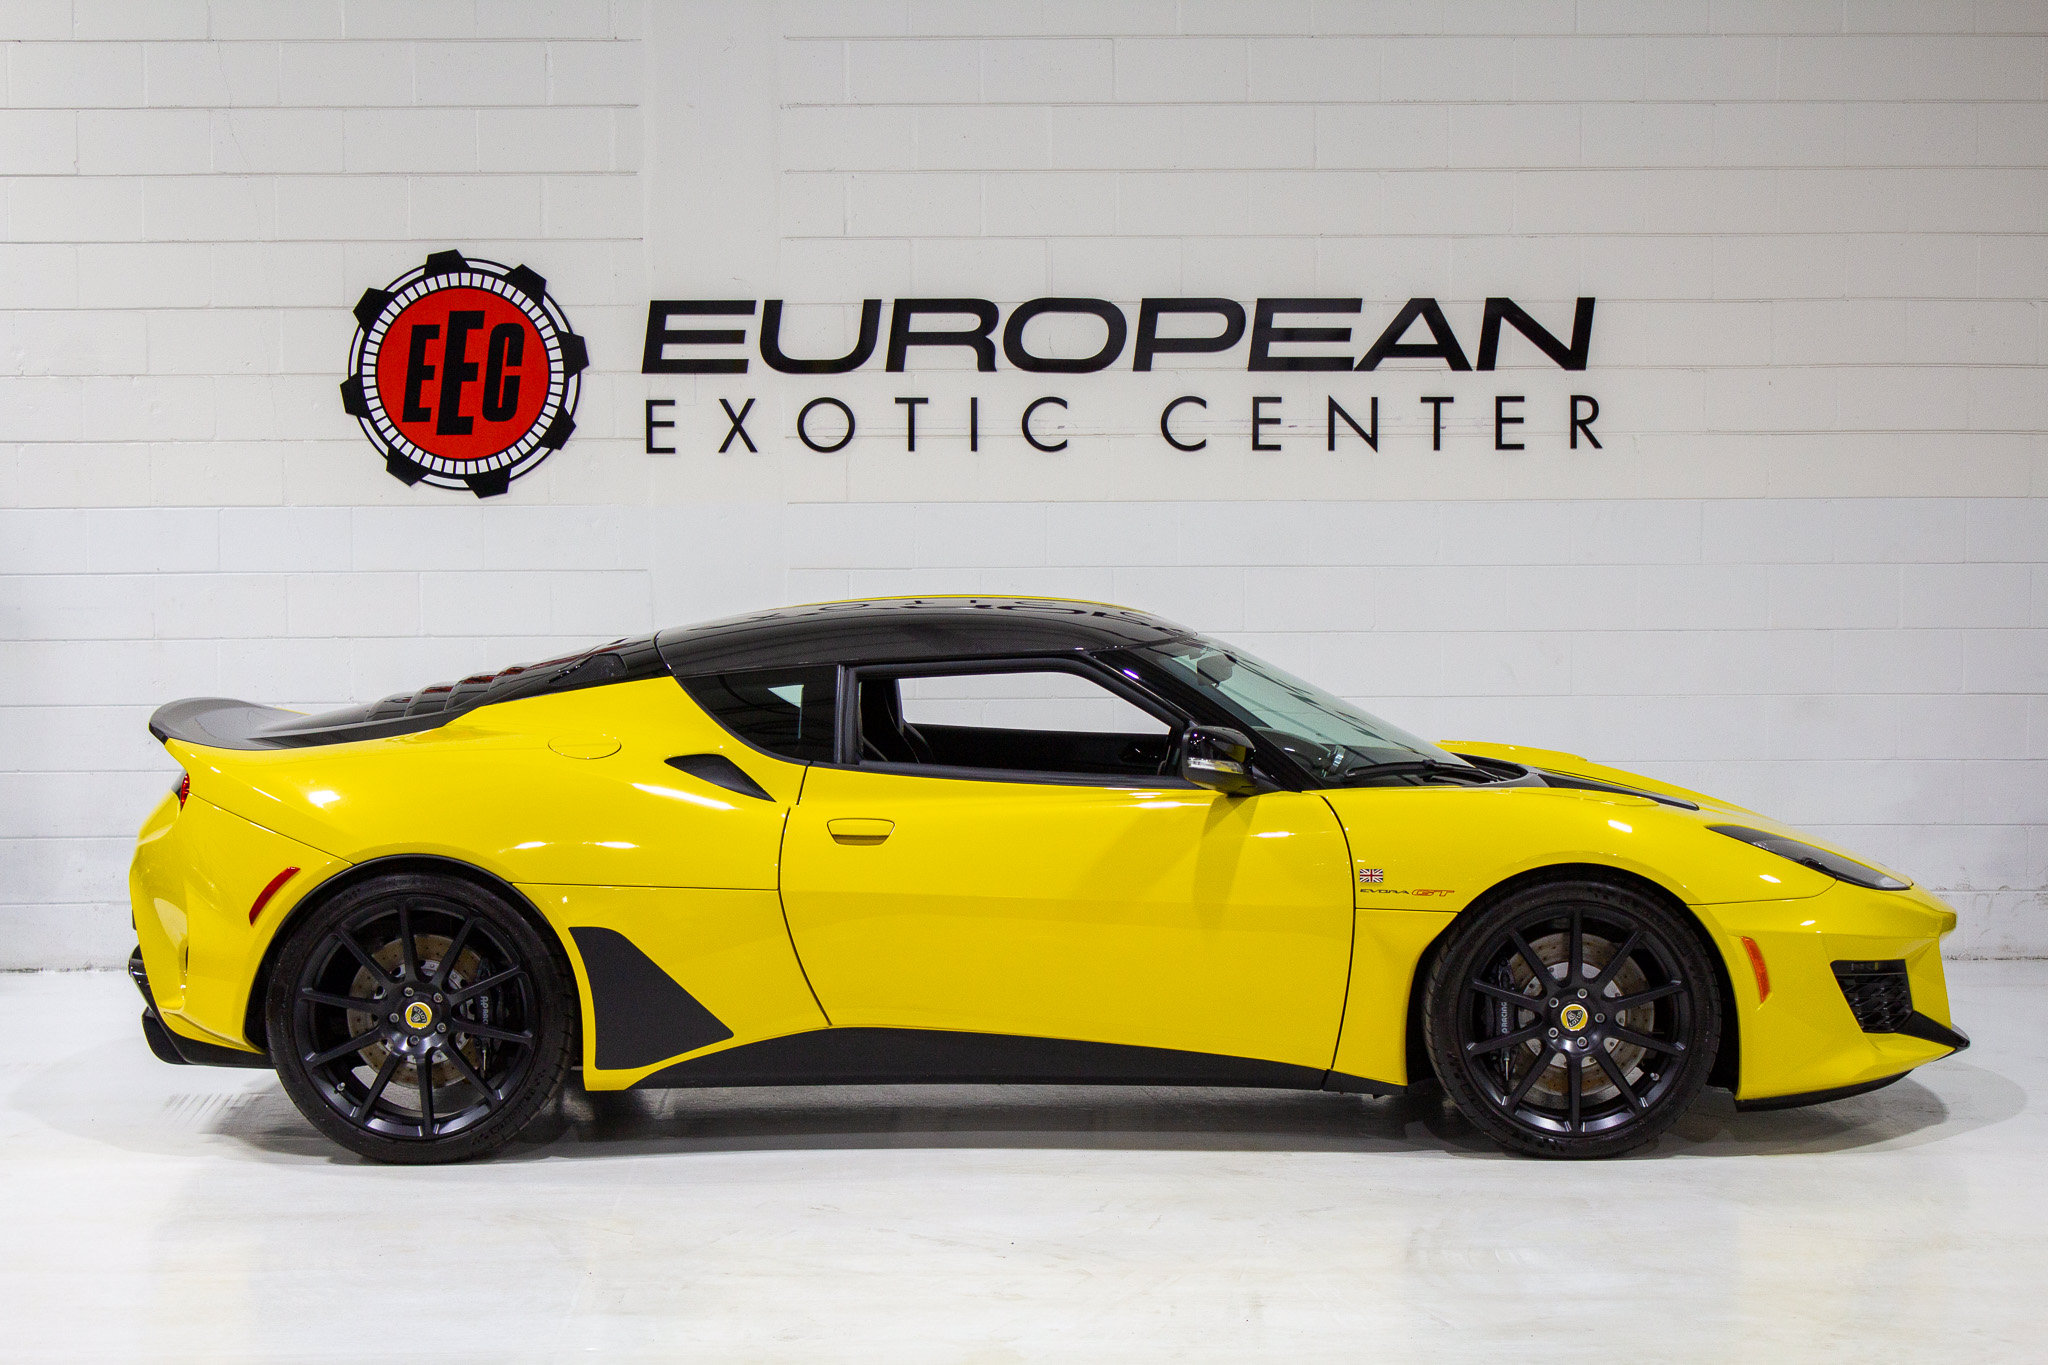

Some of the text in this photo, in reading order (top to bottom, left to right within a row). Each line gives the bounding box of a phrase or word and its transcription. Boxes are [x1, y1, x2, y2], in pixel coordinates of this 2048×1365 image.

[641, 297, 1596, 374] EUROPEAN
[402, 310, 525, 436] EEC
[646, 395, 1603, 453] EXOTIC CENTER
[1411, 888, 1455, 897] GT
